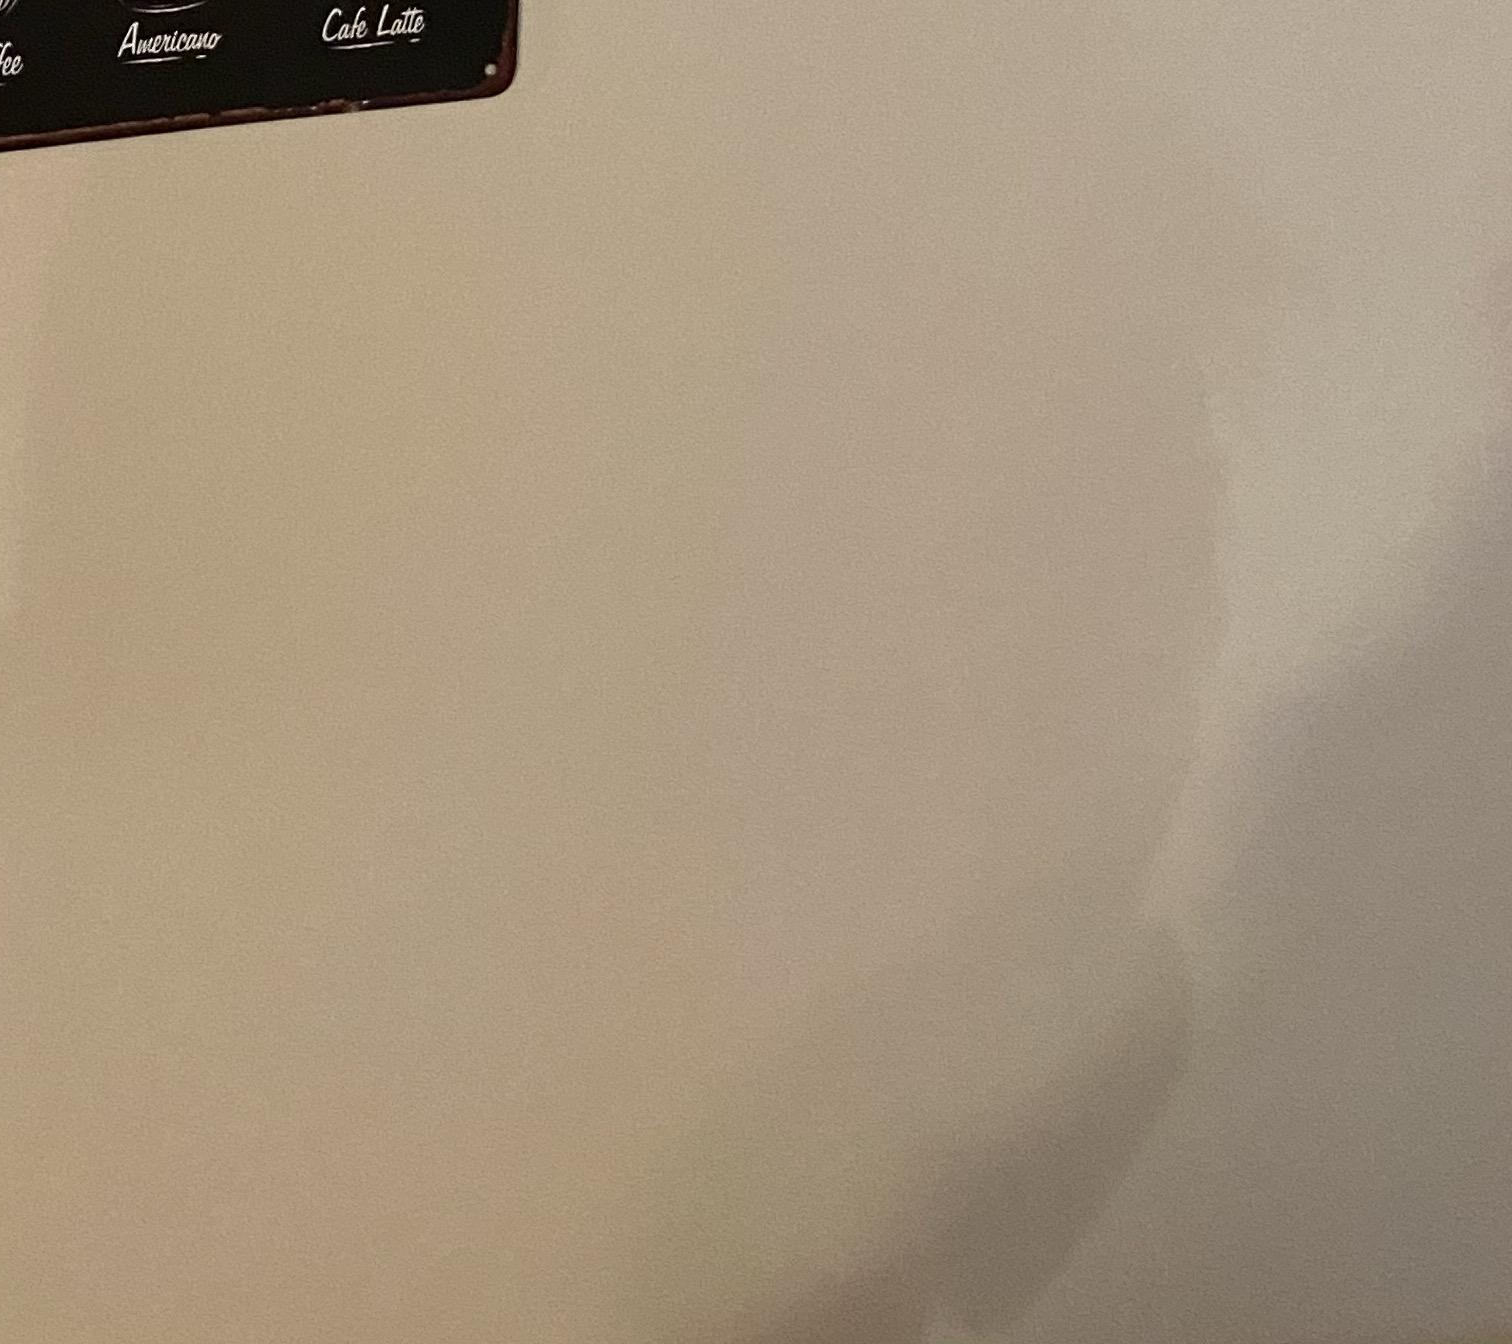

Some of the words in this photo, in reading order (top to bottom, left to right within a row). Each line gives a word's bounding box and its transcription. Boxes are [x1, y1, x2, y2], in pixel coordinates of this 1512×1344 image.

[117, 23, 222, 59] Americano
[322, 6, 368, 43] Cafe
[377, 3, 426, 38] Latte
